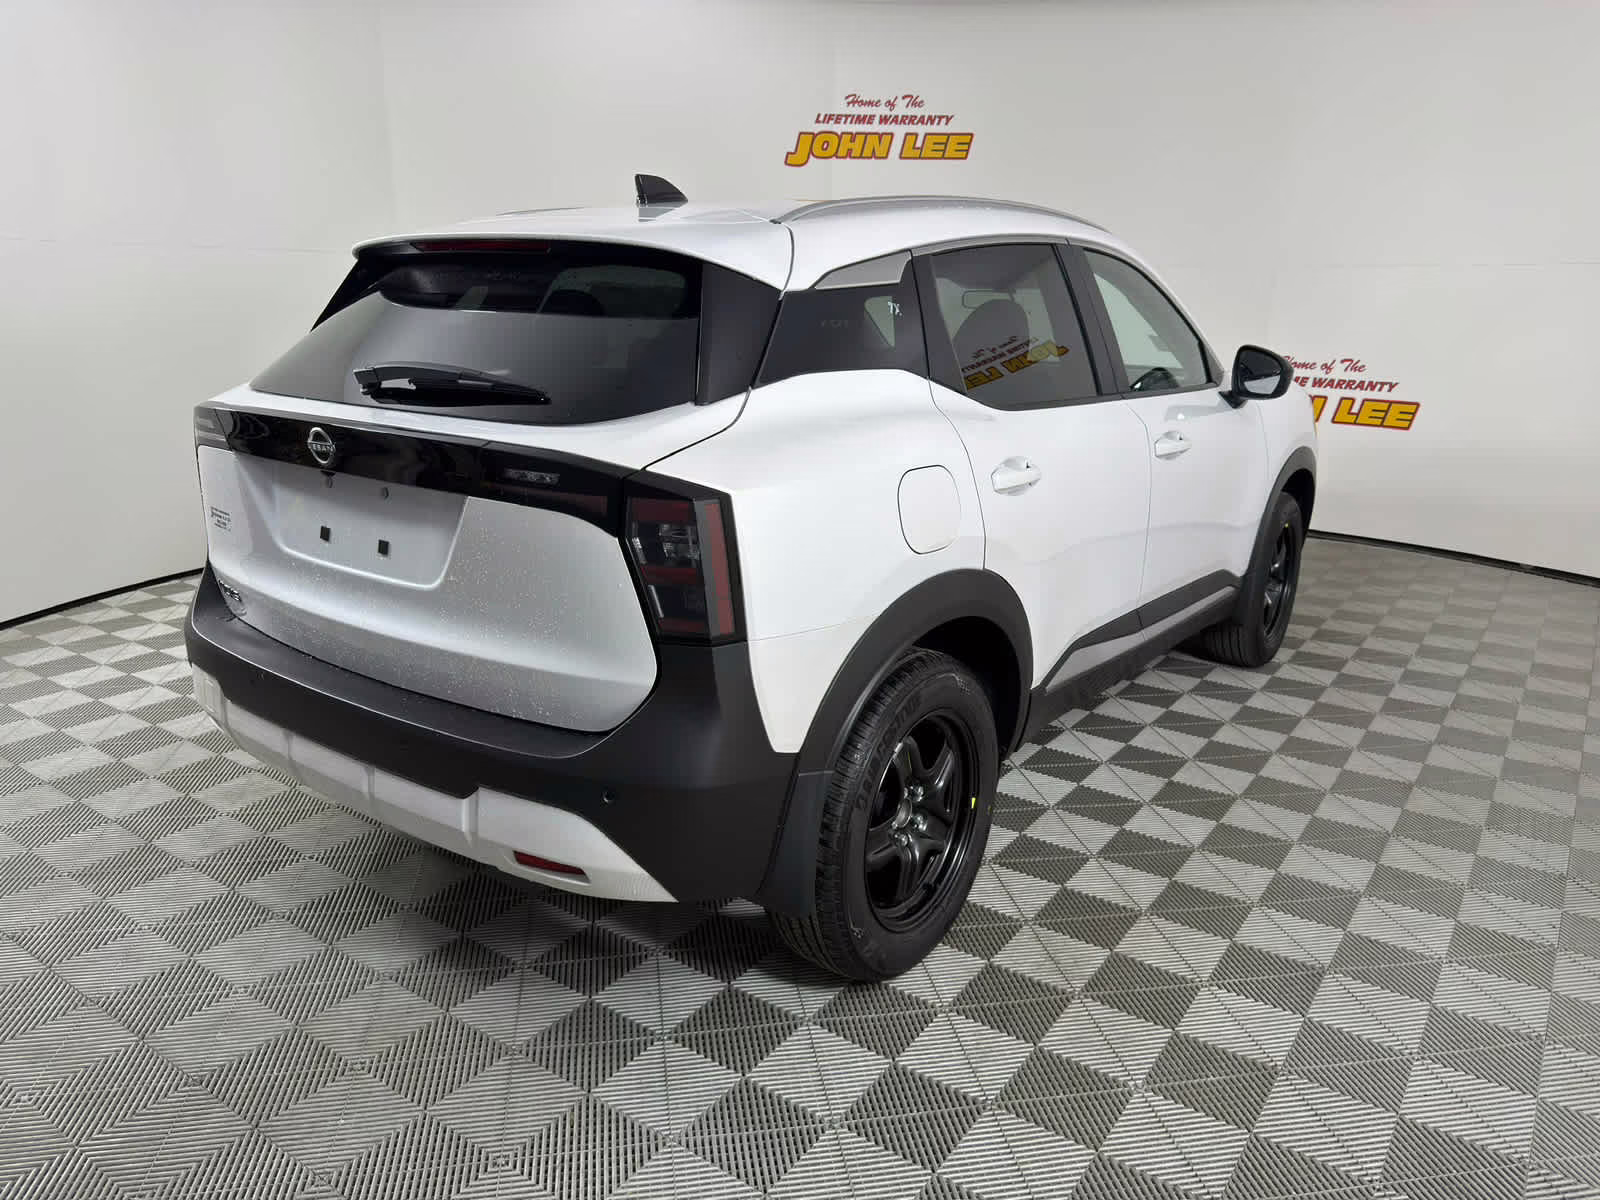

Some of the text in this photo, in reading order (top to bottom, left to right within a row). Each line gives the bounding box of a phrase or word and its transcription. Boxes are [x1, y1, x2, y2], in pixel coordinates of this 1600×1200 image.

[844, 93, 925, 111] Home of The
[814, 113, 954, 126] LIFETIME WARRANTY
[784, 130, 974, 167] JOHN LEE
[1321, 359, 1336, 375] of
[1340, 358, 1366, 373] The
[1312, 376, 1399, 393] WARRANTY
[1331, 397, 1420, 430] LEE
